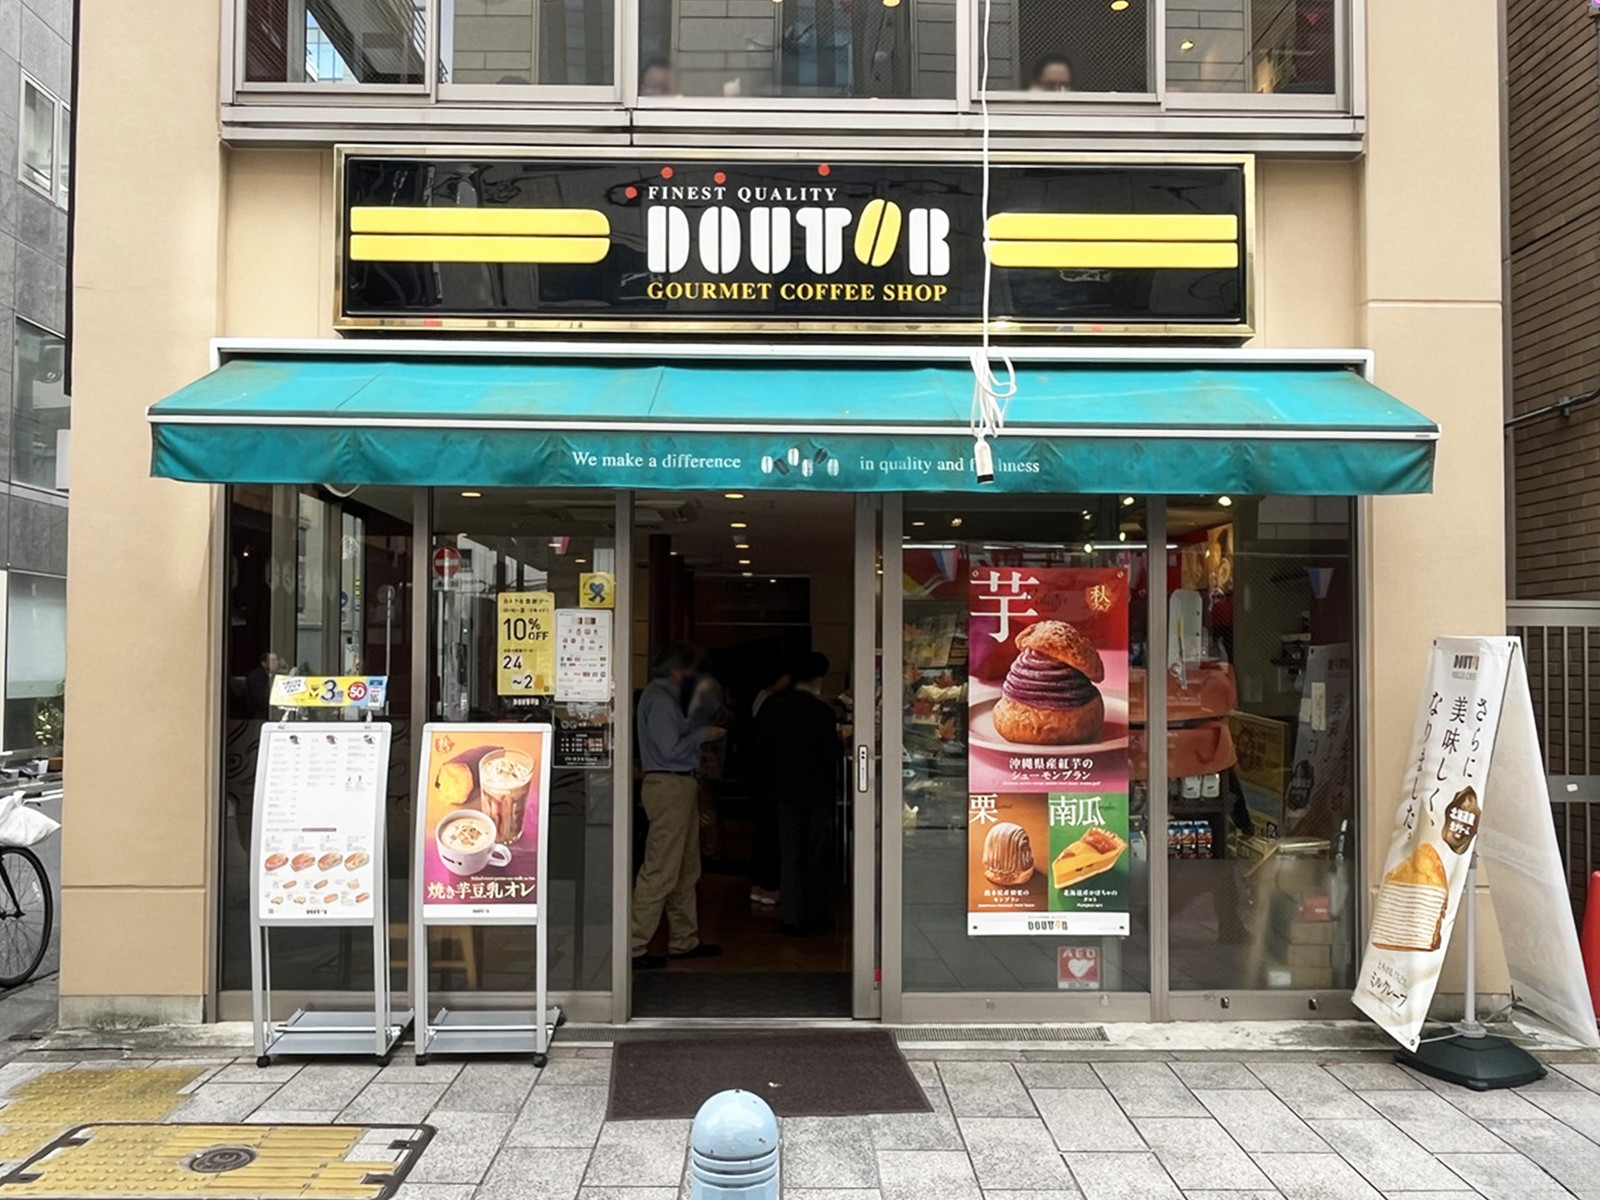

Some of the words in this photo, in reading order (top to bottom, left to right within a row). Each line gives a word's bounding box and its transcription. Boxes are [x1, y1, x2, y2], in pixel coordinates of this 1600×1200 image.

[648, 186, 727, 200] FINEST
[738, 187, 838, 203] QUALITY
[647, 198, 950, 276] DOUTOR
[647, 282, 772, 300] GOURMET
[780, 283, 875, 301] COFFEE
[883, 284, 948, 302] SHOP
[572, 452, 597, 466] We
[602, 453, 643, 467] make
[648, 458, 657, 468] a
[662, 454, 741, 468] difference
[860, 456, 874, 470] in
[879, 456, 932, 474] quality
[937, 458, 964, 471] and
[970, 458, 1040, 473] fhness
[970, 571, 1040, 643] 芋
[528, 631, 549, 640] OFF
[503, 655, 522, 670] 24
[1463, 698, 1487, 778] さらに
[1012, 770, 1091, 780] シューモンブラン
[969, 793, 998, 825] 栗
[1049, 795, 1106, 827] 南瓜
[428, 881, 536, 900] 焼き芋豆乳オレ
[1062, 948, 1097, 958] AED
